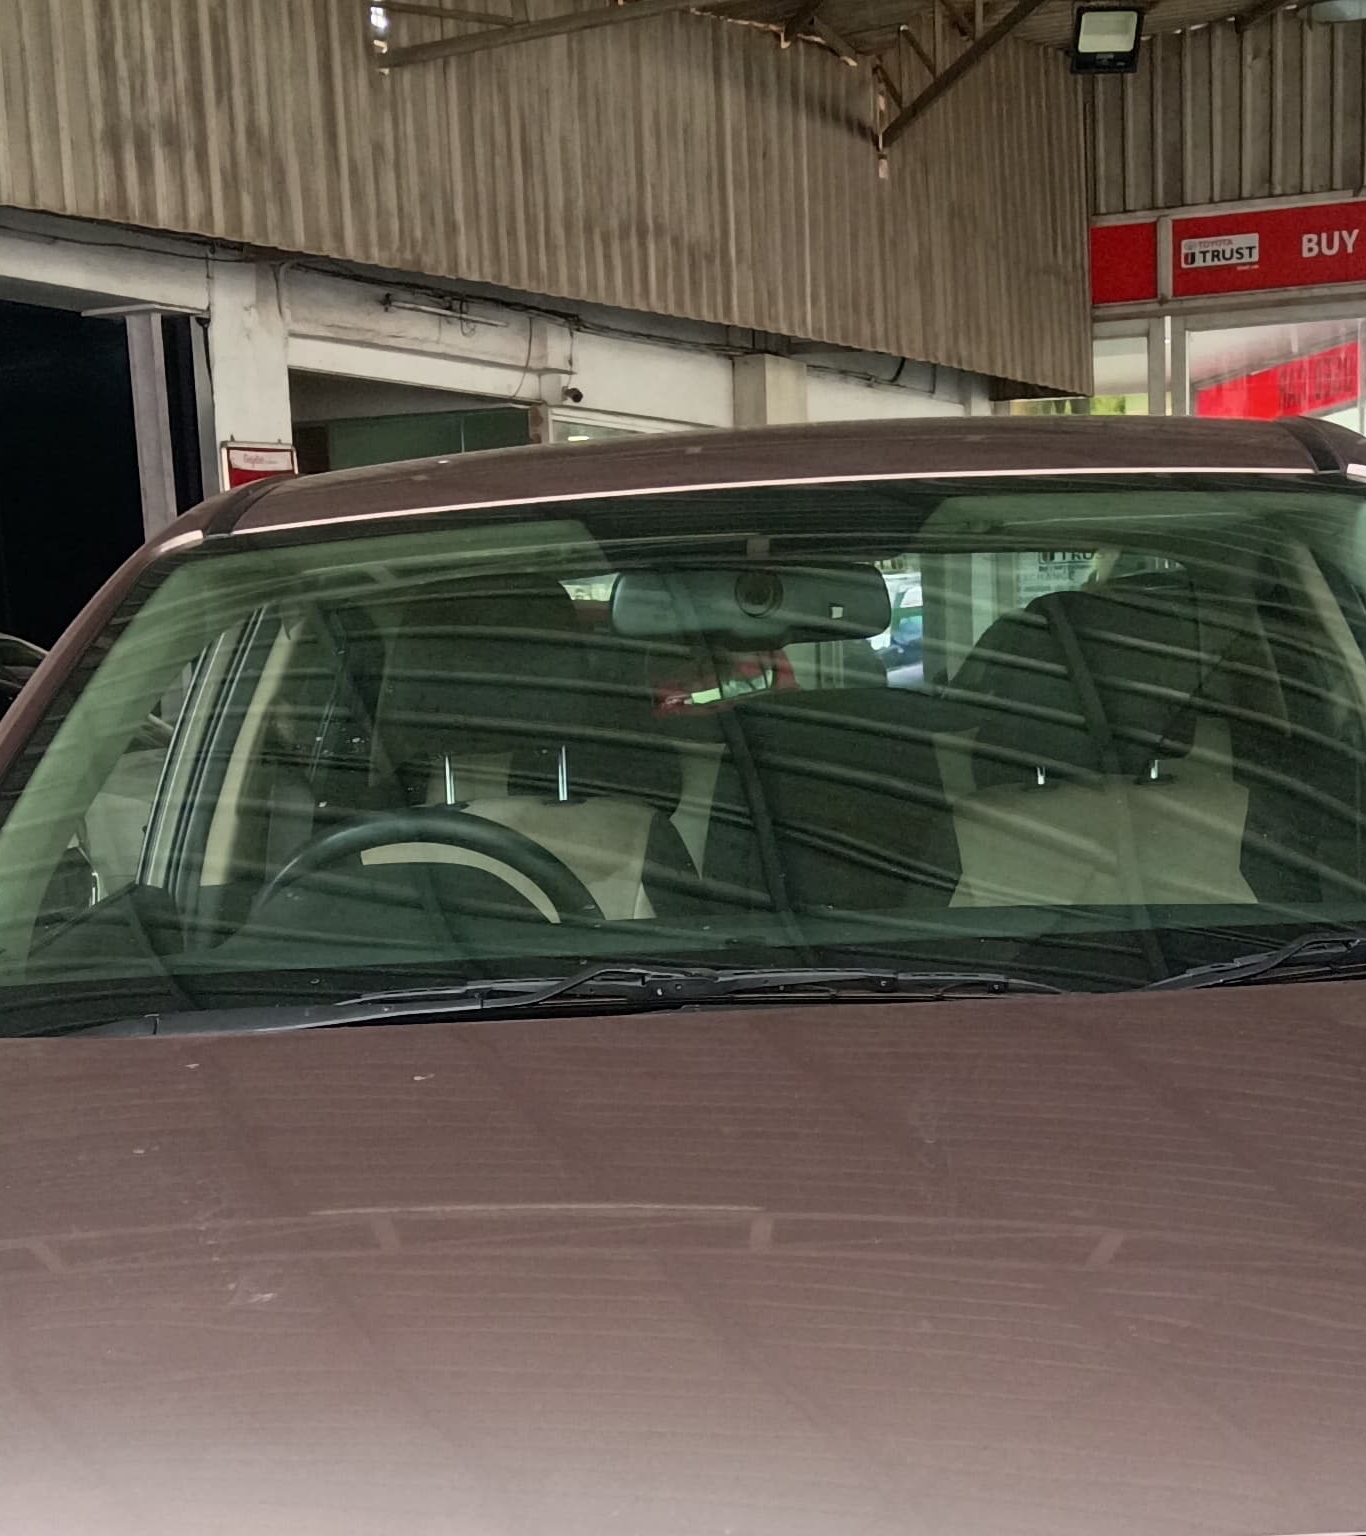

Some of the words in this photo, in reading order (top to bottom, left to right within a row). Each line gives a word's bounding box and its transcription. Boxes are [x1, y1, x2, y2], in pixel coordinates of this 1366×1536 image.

[1198, 238, 1234, 250] TOYOTA
[1302, 228, 1360, 258] BUY
[1199, 246, 1257, 263] TRUST
